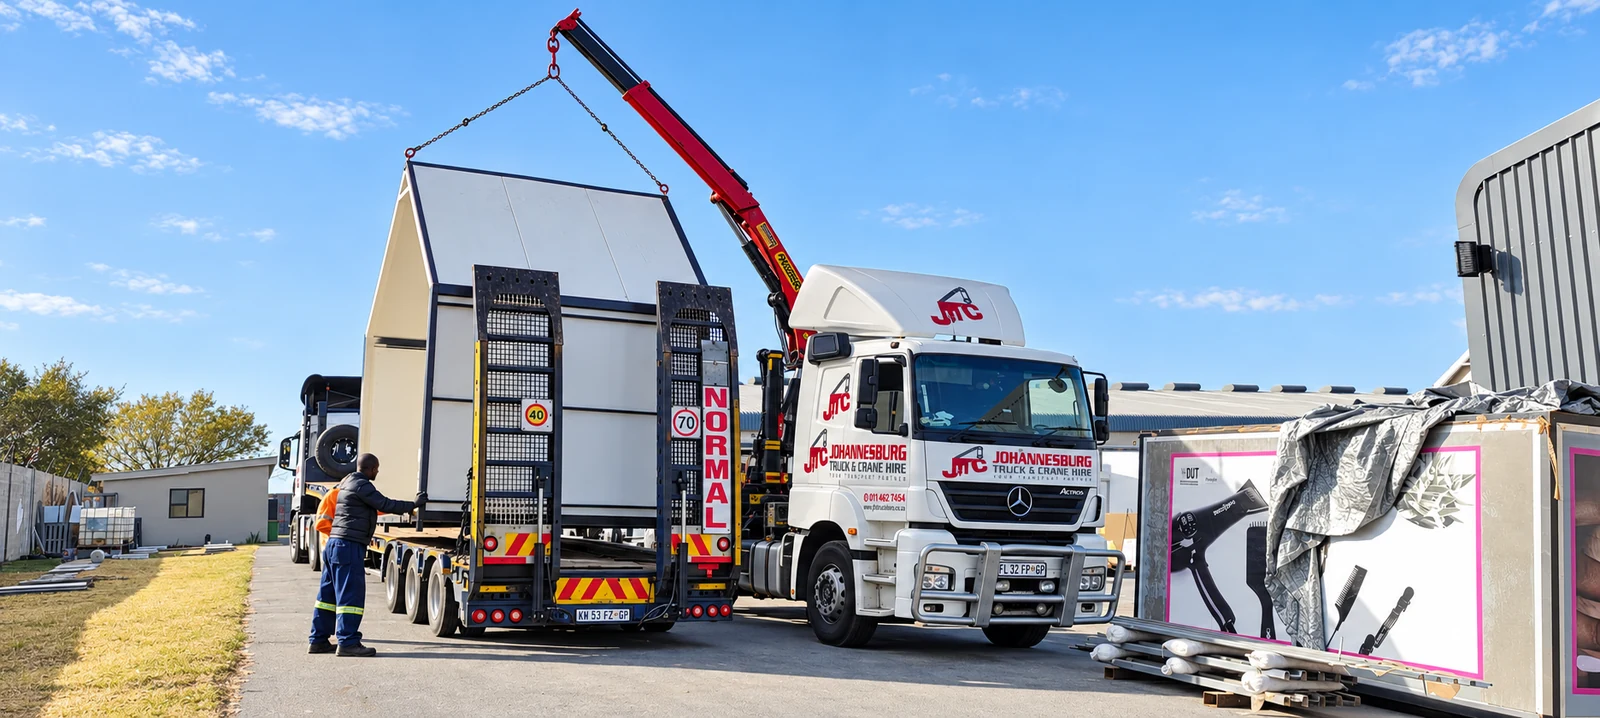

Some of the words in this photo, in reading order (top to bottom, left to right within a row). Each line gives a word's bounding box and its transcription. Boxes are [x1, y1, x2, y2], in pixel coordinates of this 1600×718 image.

[529, 410, 544, 420] 40
[678, 416, 695, 430] 70
[704, 388, 729, 529] NORMAL
[829, 444, 907, 461] JOHANNESBURG
[992, 451, 1092, 468] JOHANNESBURG
[829, 461, 850, 472] TRUCK
[851, 462, 857, 472] &
[858, 462, 883, 473] CRANE
[886, 463, 907, 474] HIRE
[993, 464, 1025, 474] TRUCK
[1029, 466, 1035, 475] &
[1038, 466, 1069, 476] CRANE
[1072, 468, 1092, 477] HIRE
[1186, 467, 1200, 479] DUT
[869, 493, 878, 502] 011
[999, 564, 1008, 575] FL
[1010, 564, 1019, 575] 32
[1021, 564, 1030, 575] FP
[1035, 564, 1045, 575] GP
[591, 610, 601, 620] 53
[603, 610, 613, 620] FZ
[618, 610, 629, 620] GP
